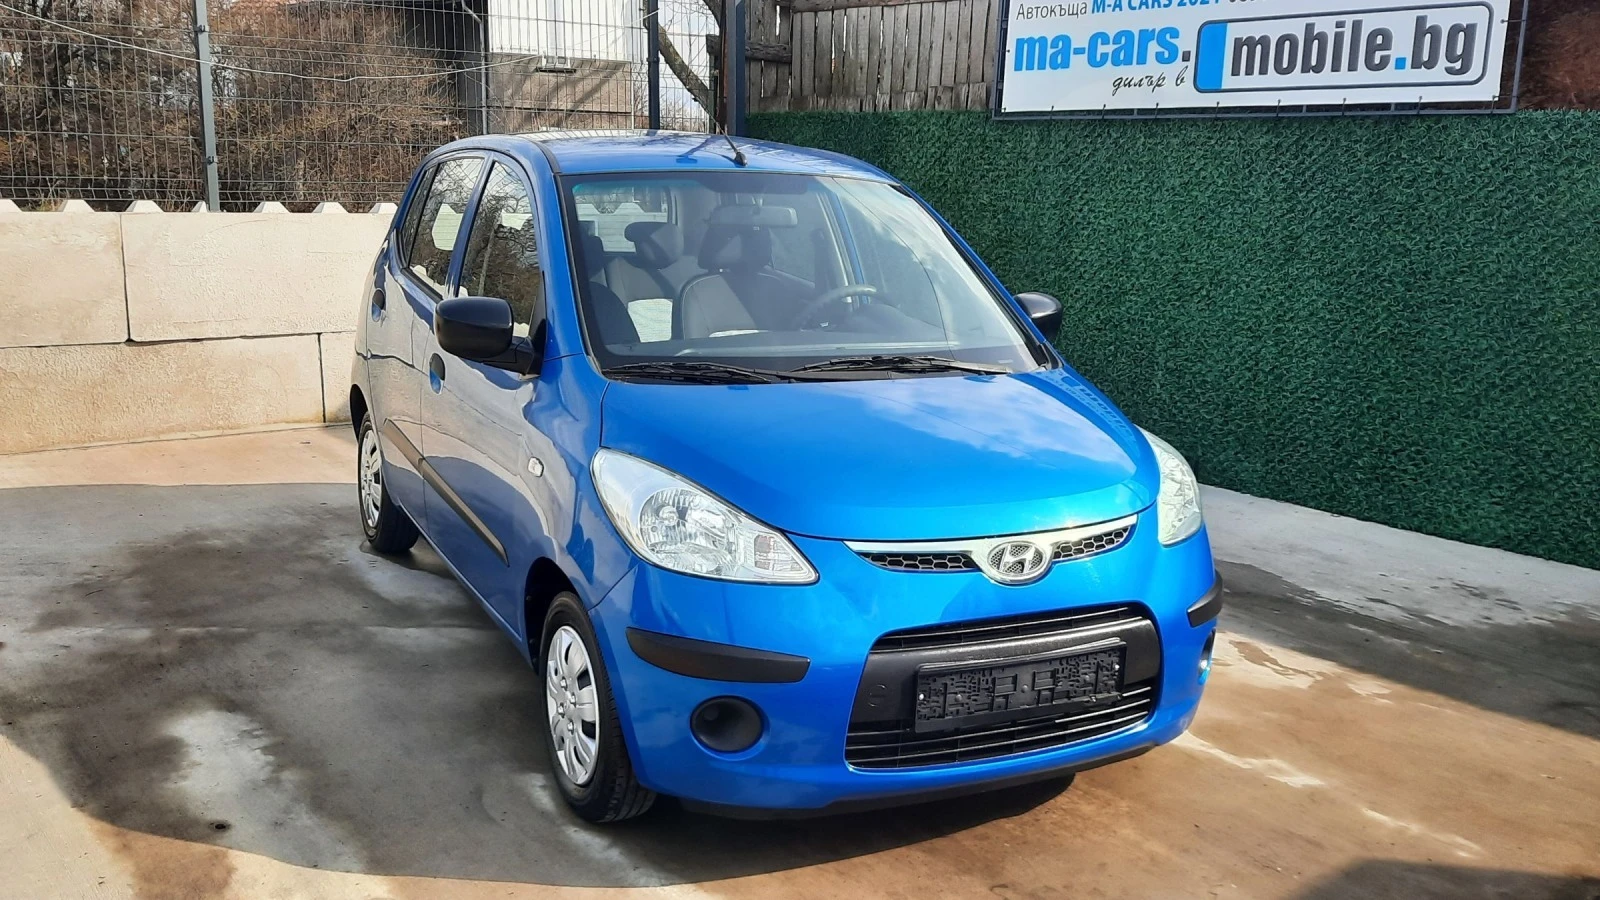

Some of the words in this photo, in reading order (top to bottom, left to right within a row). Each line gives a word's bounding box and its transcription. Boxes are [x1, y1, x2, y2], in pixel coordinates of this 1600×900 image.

[1016, 2, 1088, 20] Автокъща
[1230, 15, 1478, 76] mobile.bg
[1112, 72, 1166, 96] дилър
